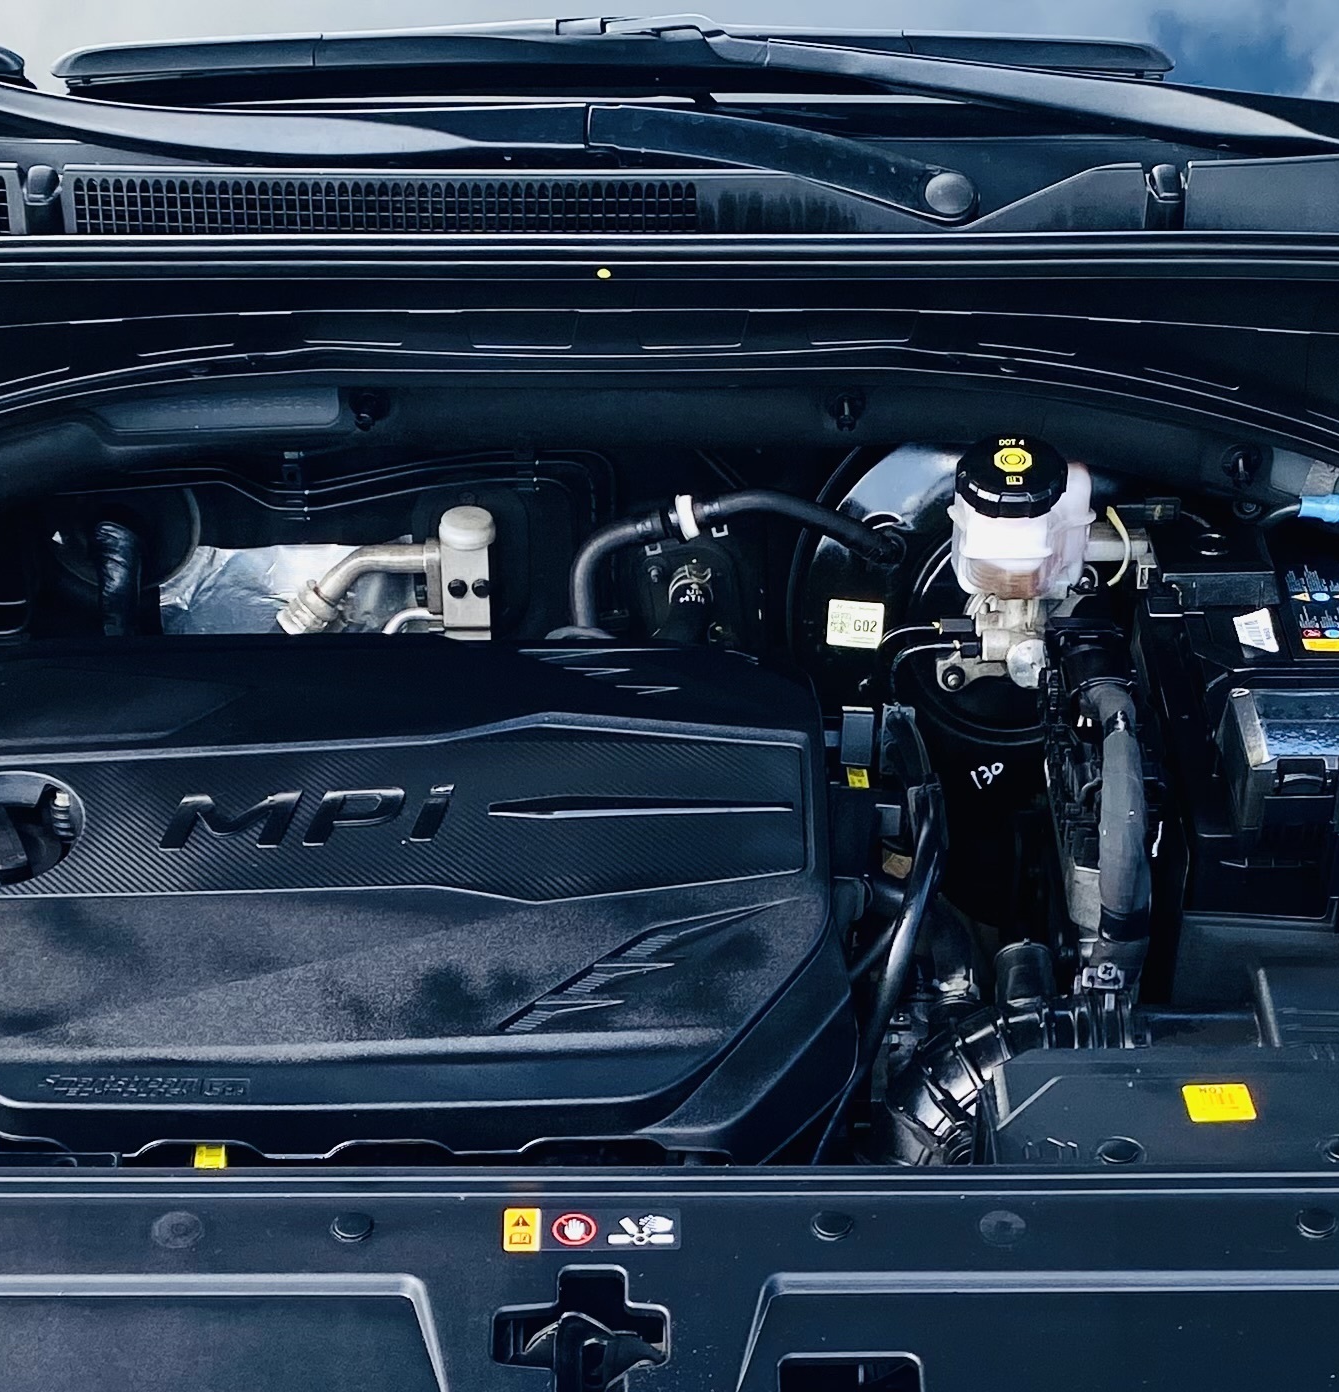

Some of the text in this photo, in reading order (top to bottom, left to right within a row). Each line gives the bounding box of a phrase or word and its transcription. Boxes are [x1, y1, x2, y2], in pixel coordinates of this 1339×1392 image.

[998, 438, 1025, 446] DOT 4
[853, 619, 878, 633] G02
[969, 761, 1004, 790] 130
